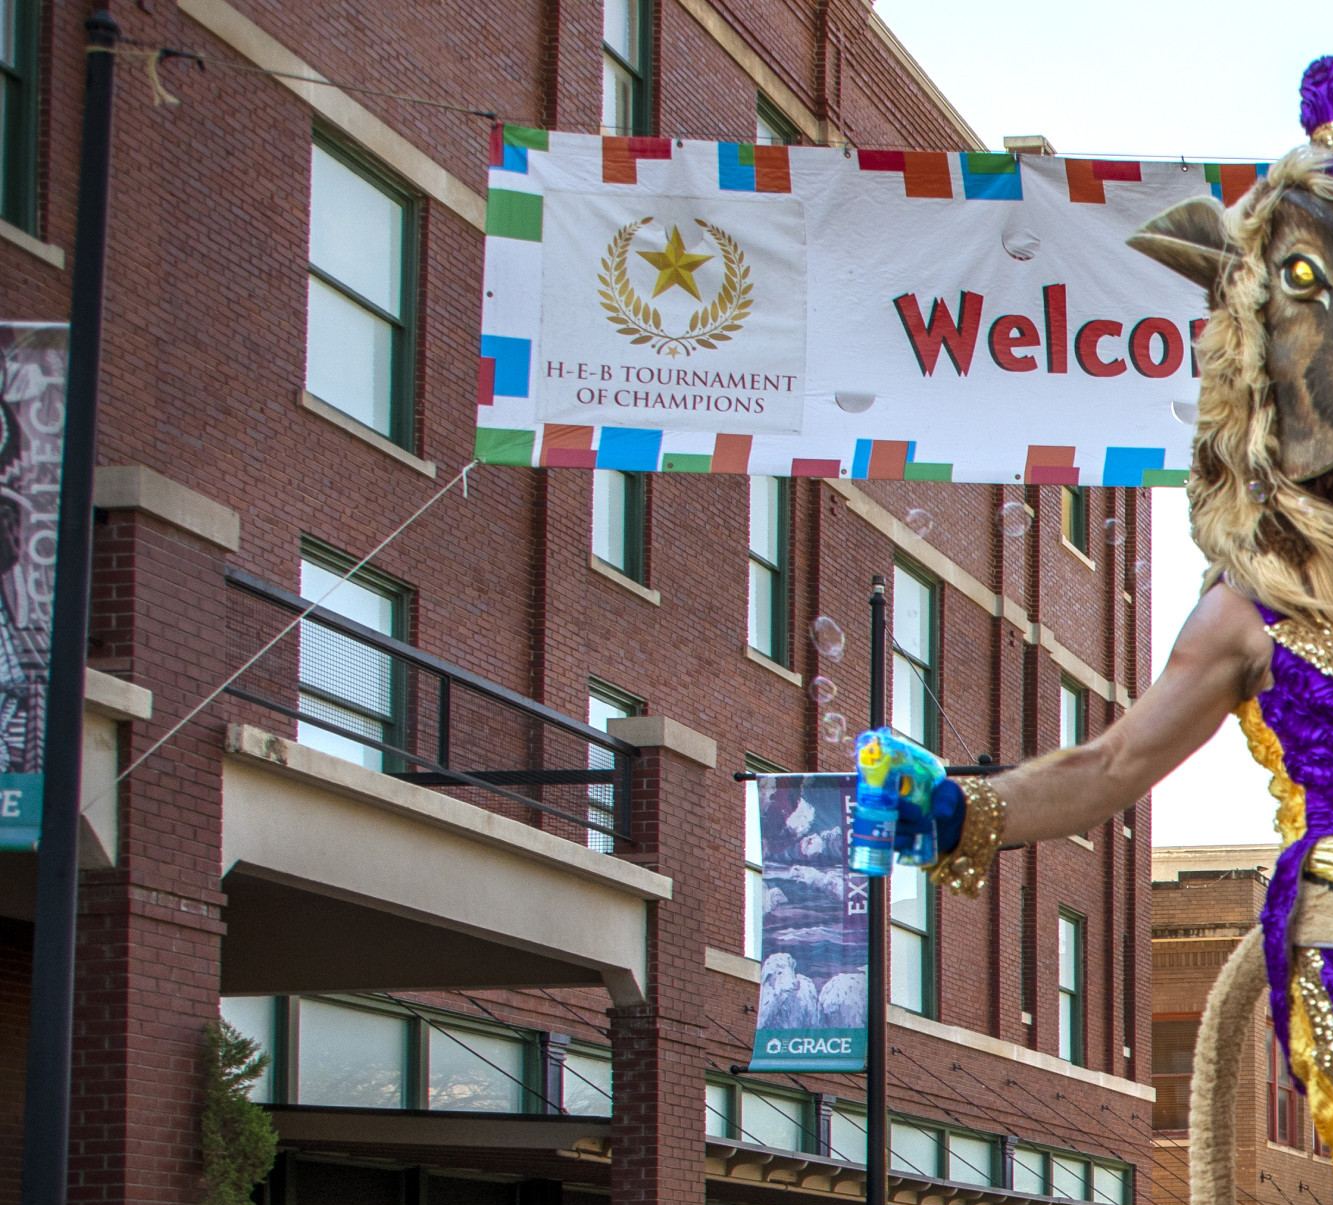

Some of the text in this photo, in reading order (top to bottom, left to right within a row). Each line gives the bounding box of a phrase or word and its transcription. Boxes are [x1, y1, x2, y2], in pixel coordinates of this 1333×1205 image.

[893, 283, 1208, 379] Welco
[545, 360, 797, 393] H-E-B TOURNAMENT
[576, 386, 765, 414] OF CHAMPIONS
[788, 1037, 852, 1054] GRACE
